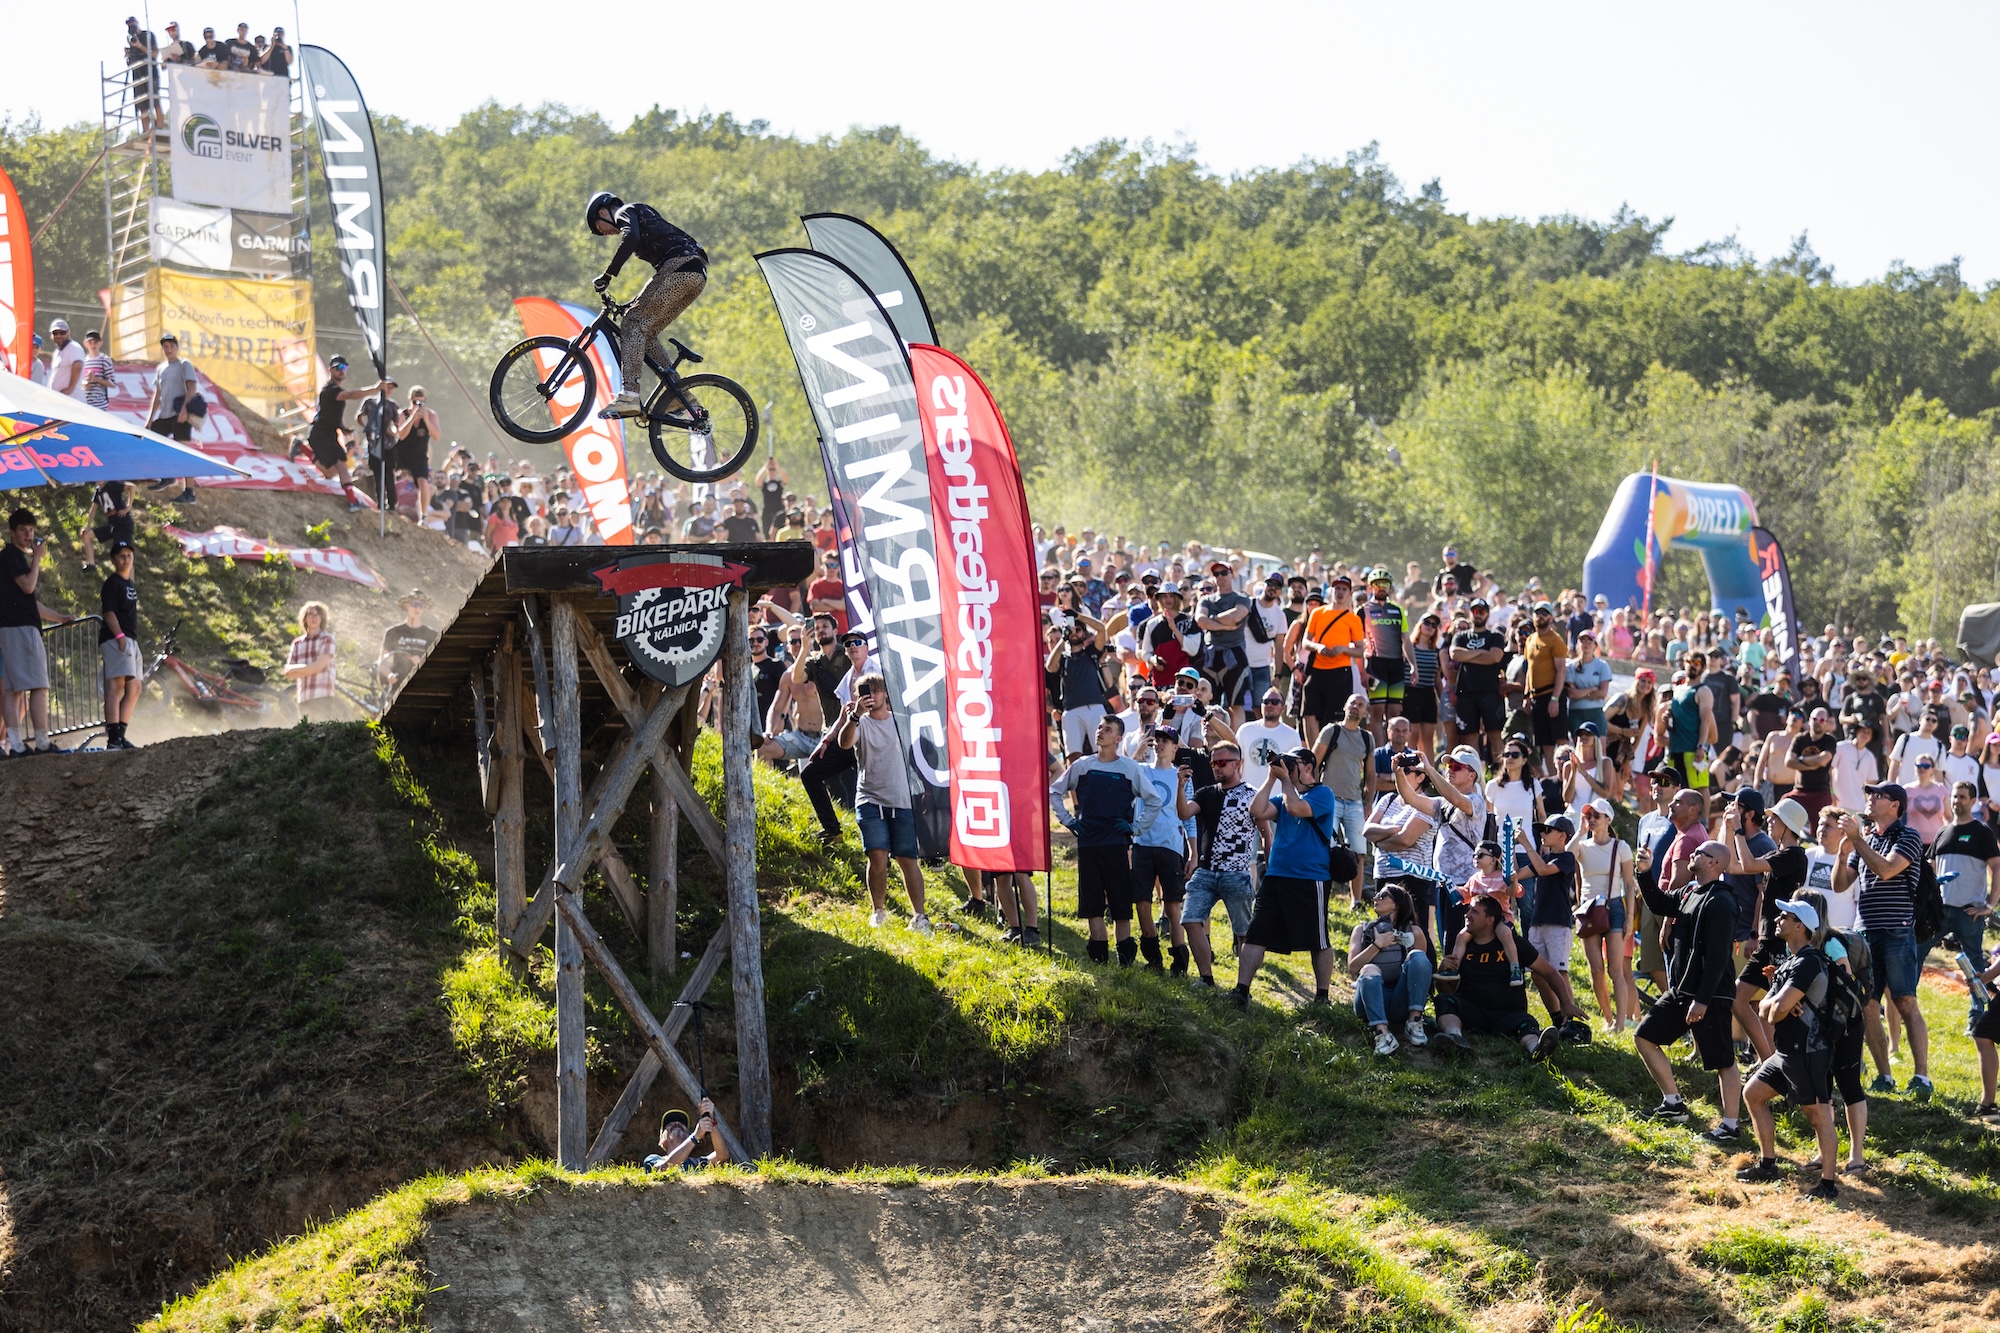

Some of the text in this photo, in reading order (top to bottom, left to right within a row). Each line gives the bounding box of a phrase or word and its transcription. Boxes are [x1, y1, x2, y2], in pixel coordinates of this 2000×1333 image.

[226, 131, 282, 152] SILVER
[226, 151, 253, 162] EVENT
[154, 222, 220, 244] GARMIN
[238, 233, 311, 252] GARMIN
[1684, 494, 1742, 536] BIRELL
[616, 582, 732, 639] BIKEPARK
